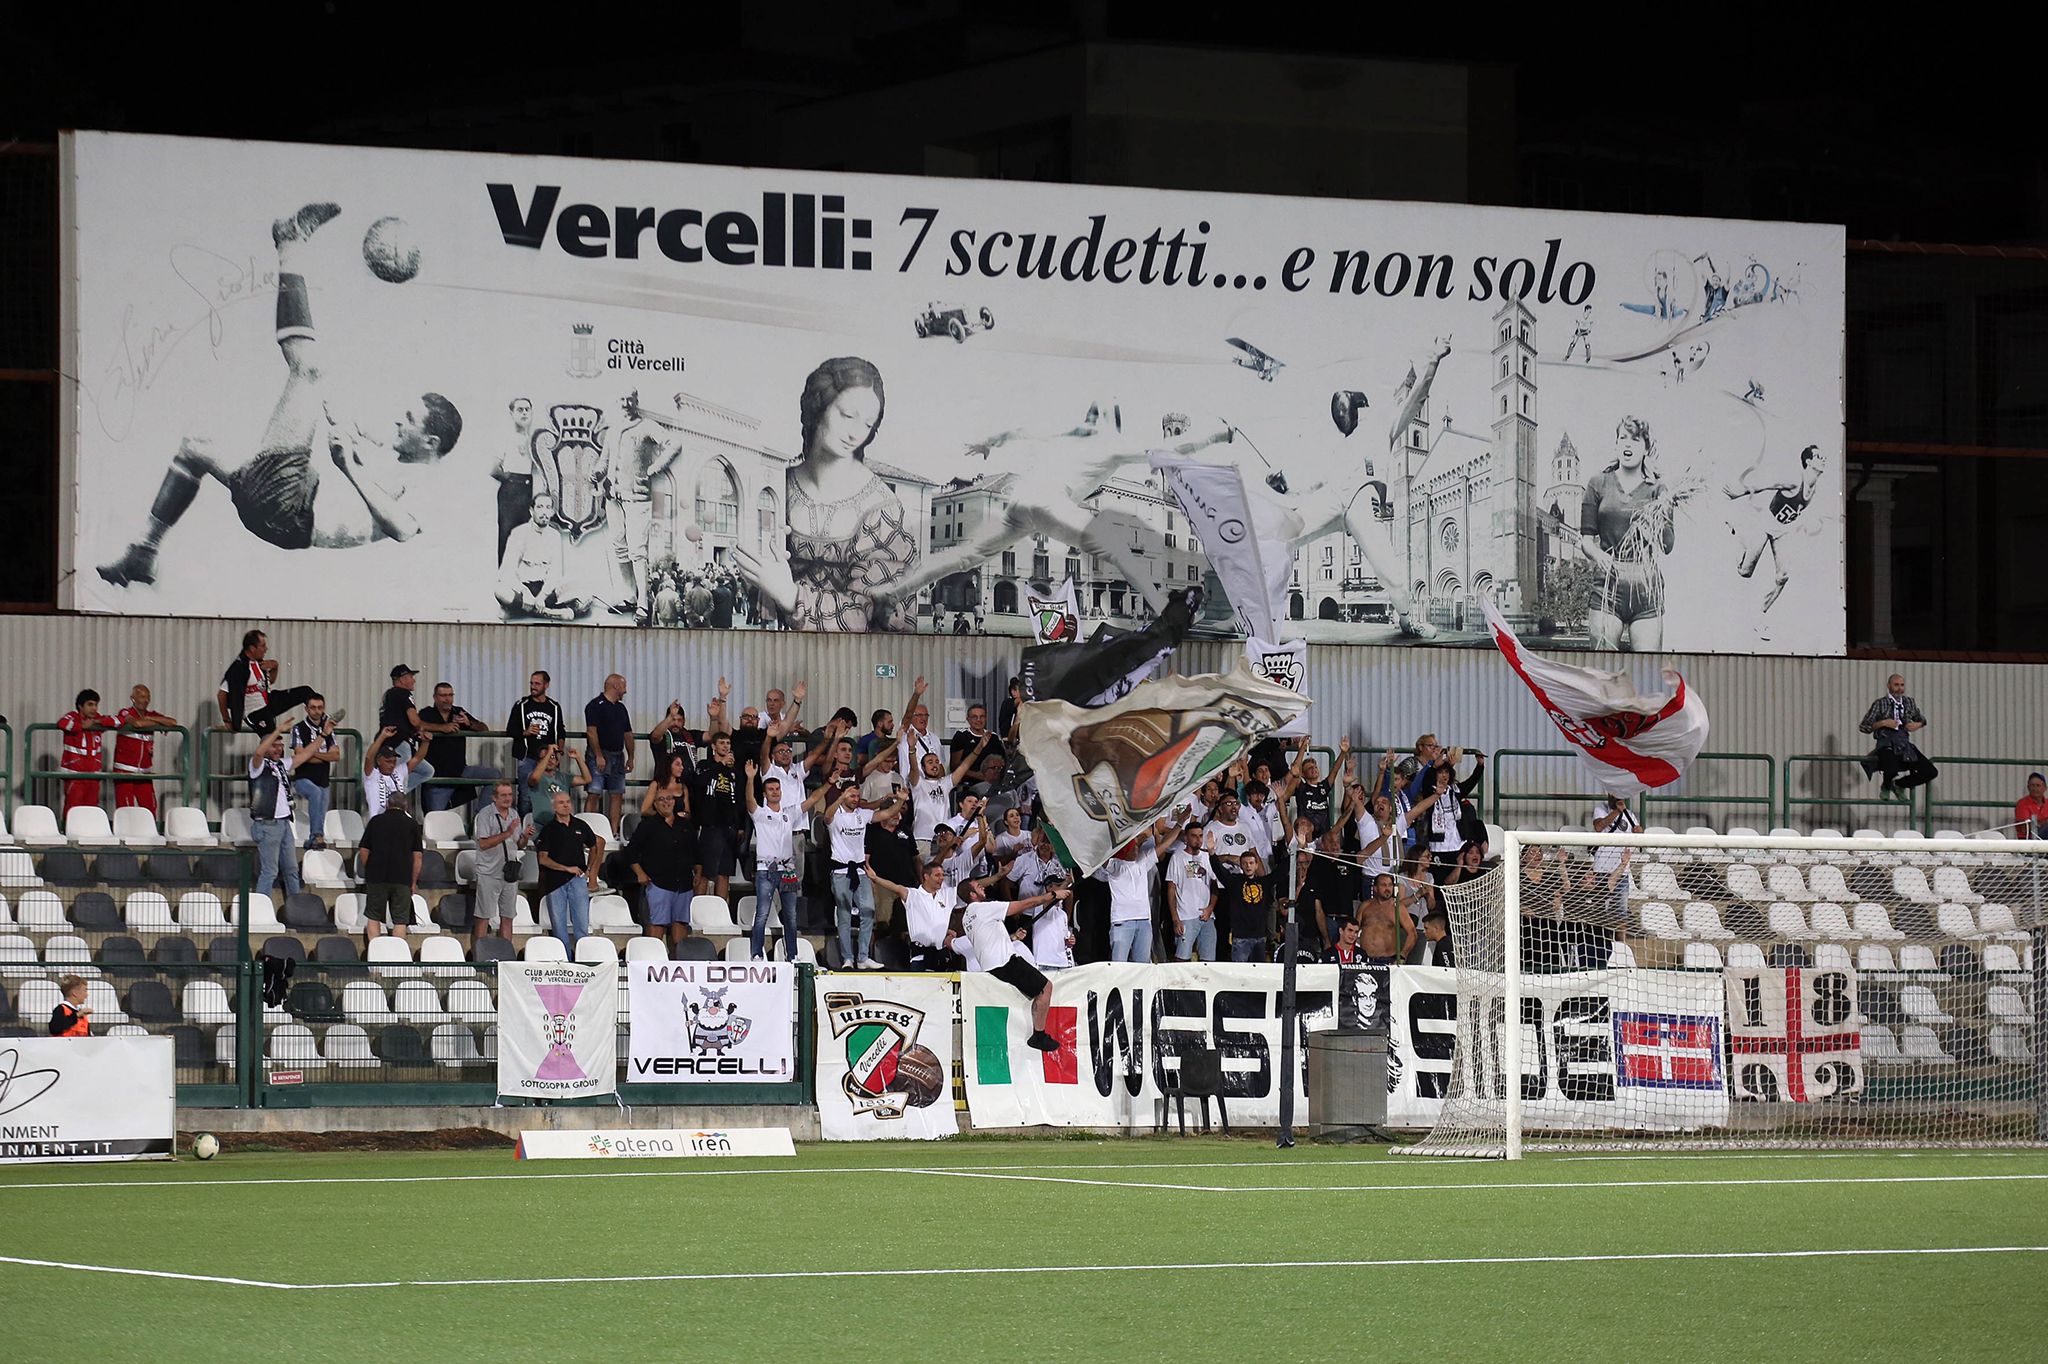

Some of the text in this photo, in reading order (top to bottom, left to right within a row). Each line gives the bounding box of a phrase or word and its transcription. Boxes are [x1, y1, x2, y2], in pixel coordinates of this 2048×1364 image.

[486, 182, 1597, 306] Vercelli: 7 scudetti... e non solo
[607, 339, 645, 355] Città
[607, 355, 685, 372] di Vercelli
[524, 968, 596, 979] CLUB AMEDEO ROSA
[647, 965, 777, 983] MAI DOMI
[840, 1007, 914, 1028] ultras
[1087, 987, 1333, 1098] WEST
[1409, 990, 1615, 1101] SIDE
[859, 1037, 889, 1073] Vercelli
[633, 1056, 787, 1075] VERCELLI
[520, 1079, 600, 1090] SOTTOSOPRA GROUP
[859, 1098, 895, 1107] 1892
[615, 1137, 731, 1152] atena iren
